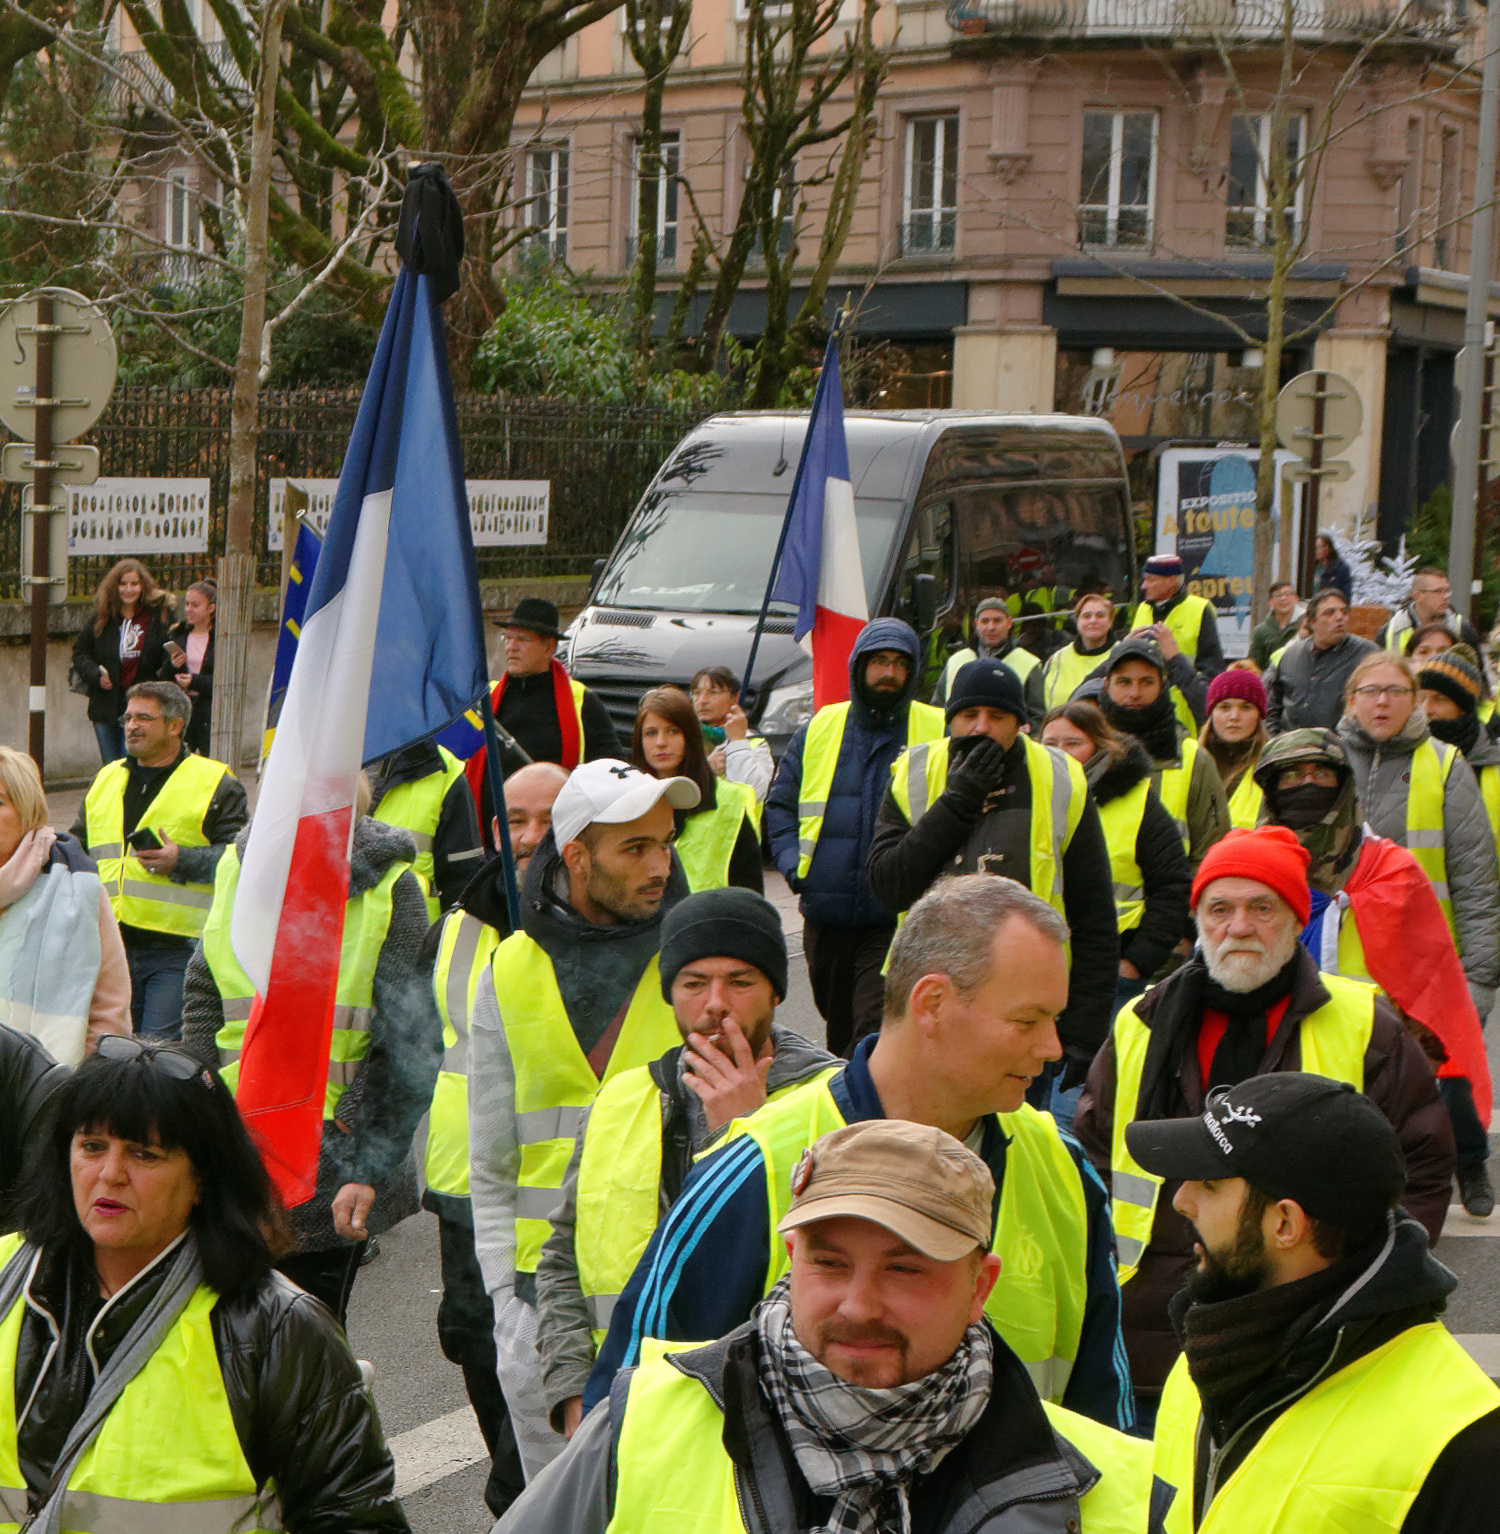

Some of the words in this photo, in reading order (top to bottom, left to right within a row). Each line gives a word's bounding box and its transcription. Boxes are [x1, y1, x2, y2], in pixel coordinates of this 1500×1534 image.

[1181, 490, 1257, 510] EXPOSITIO
[1184, 505, 1255, 534] toute
[1202, 1111, 1234, 1155] mallorca
